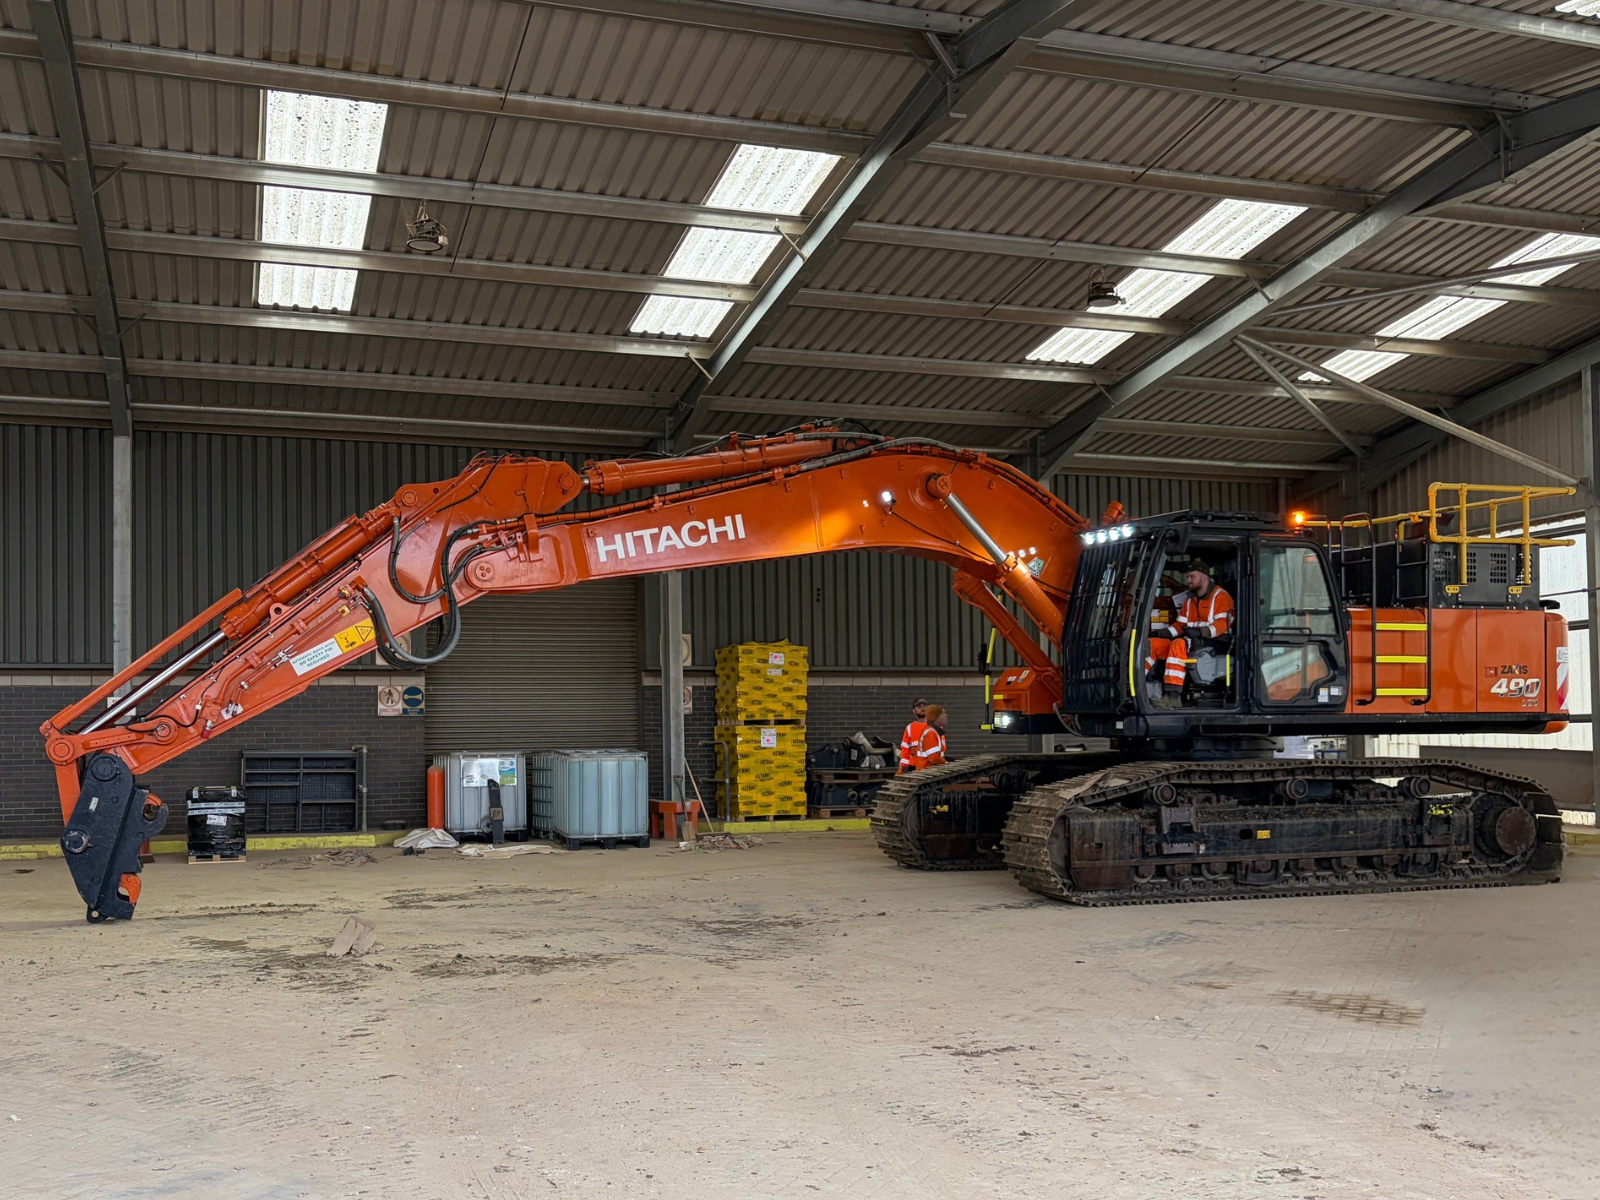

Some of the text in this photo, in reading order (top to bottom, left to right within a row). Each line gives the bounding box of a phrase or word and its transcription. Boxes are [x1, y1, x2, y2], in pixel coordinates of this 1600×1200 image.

[595, 514, 745, 562] HITACHI
[307, 651, 323, 662] SAFETY
[307, 654, 330, 667] REQUIRED
[1500, 664, 1528, 675] ZAXIS
[1490, 677, 1541, 698] 490
